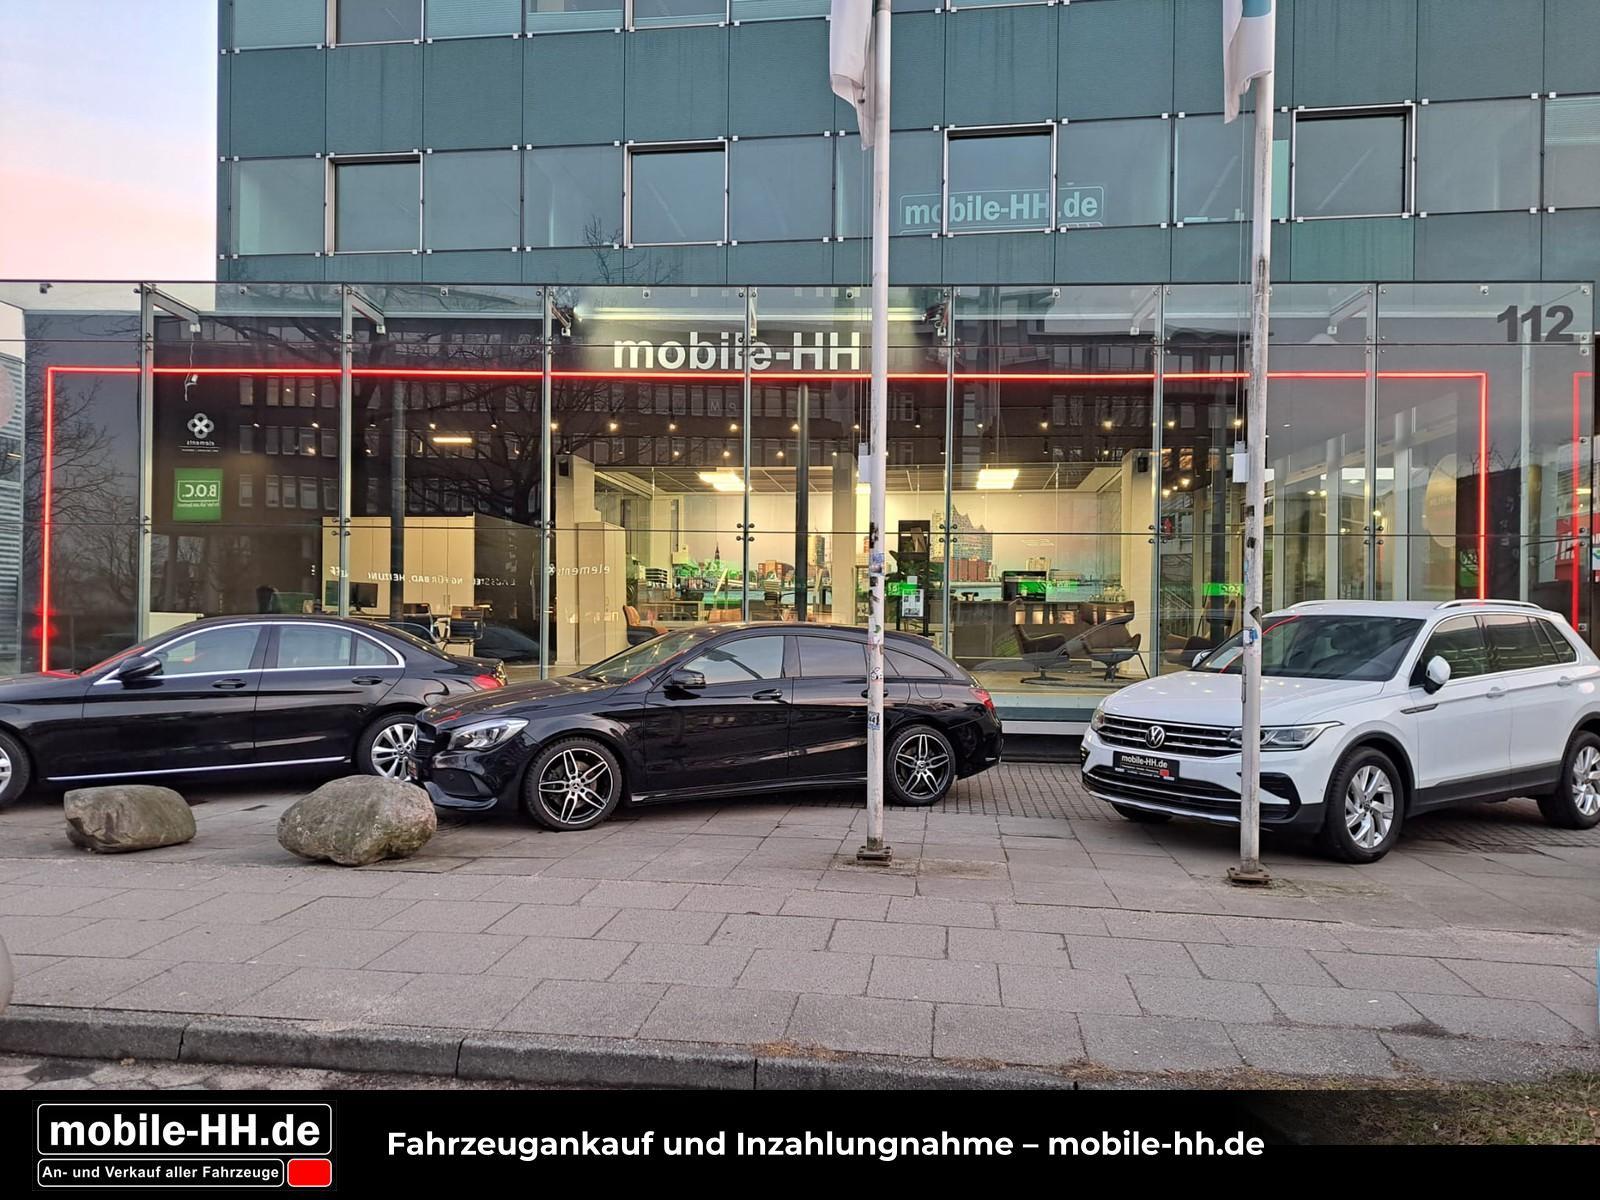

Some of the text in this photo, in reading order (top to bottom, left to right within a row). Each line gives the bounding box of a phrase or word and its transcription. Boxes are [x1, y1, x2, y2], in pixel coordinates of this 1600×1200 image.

[905, 192, 1098, 225] mobile-HH.de
[1497, 305, 1574, 342] 112
[613, 332, 860, 370] mobile-HH
[1121, 755, 1168, 768] mobile-HH.de
